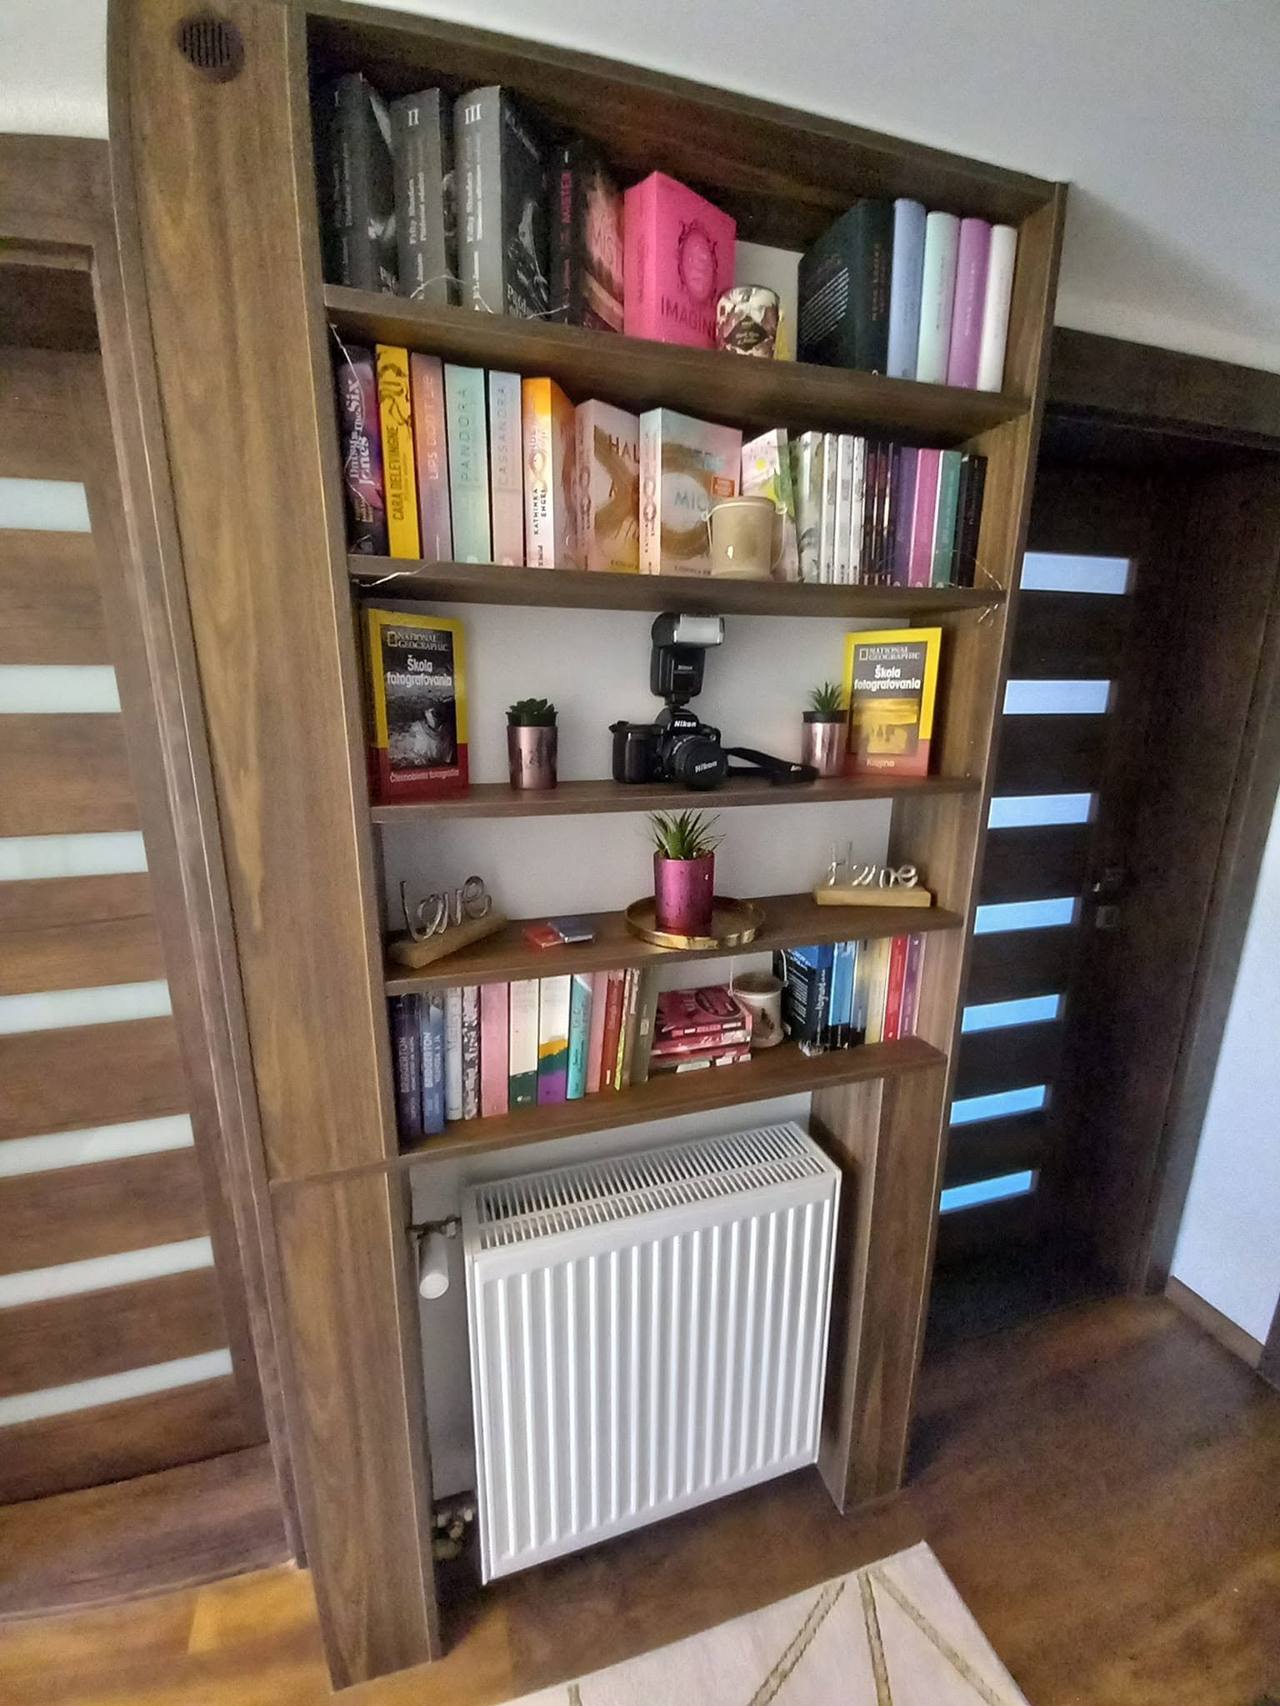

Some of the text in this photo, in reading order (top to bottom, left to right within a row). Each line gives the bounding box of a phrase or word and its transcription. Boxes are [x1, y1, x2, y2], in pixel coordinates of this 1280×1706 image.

[464, 103, 482, 125] III
[345, 380, 360, 412] Six
[457, 388, 472, 482] PANDORA
[391, 493, 404, 521] CARA
[868, 646, 908, 655] NATIONAL
[868, 652, 921, 661] GEOGRAPHIC
[407, 655, 433, 672] Škola
[874, 664, 902, 679] Škola
[387, 671, 452, 688] fotografovania
[854, 677, 922, 692] fotografovania
[674, 720, 697, 728] Nikon
[695, 761, 718, 774] Nikon
[400, 875, 492, 943] love
[423, 1031, 433, 1088] BRIDGERTON
